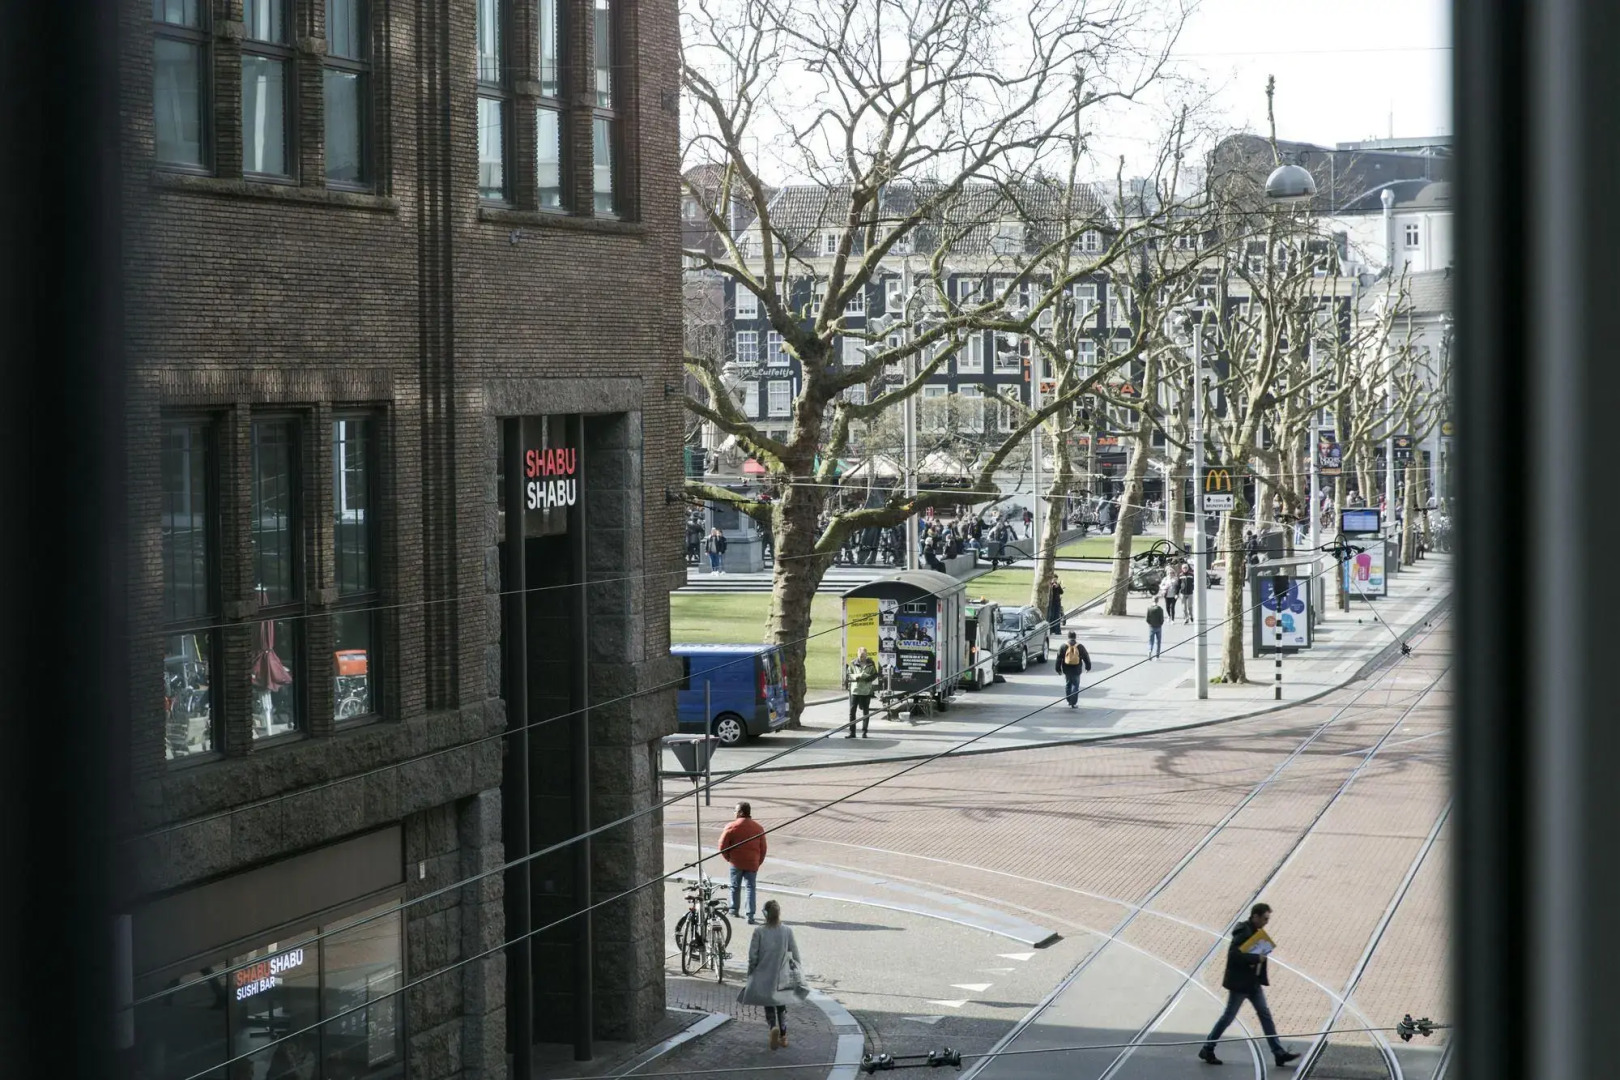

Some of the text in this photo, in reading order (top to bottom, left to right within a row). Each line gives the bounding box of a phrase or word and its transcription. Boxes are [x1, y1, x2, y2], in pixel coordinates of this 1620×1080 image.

[526, 448, 576, 478] SHABU
[527, 479, 576, 510] SHABU
[236, 948, 304, 987] SHABU SHABU
[236, 976, 276, 1001] SUSHI BAR
